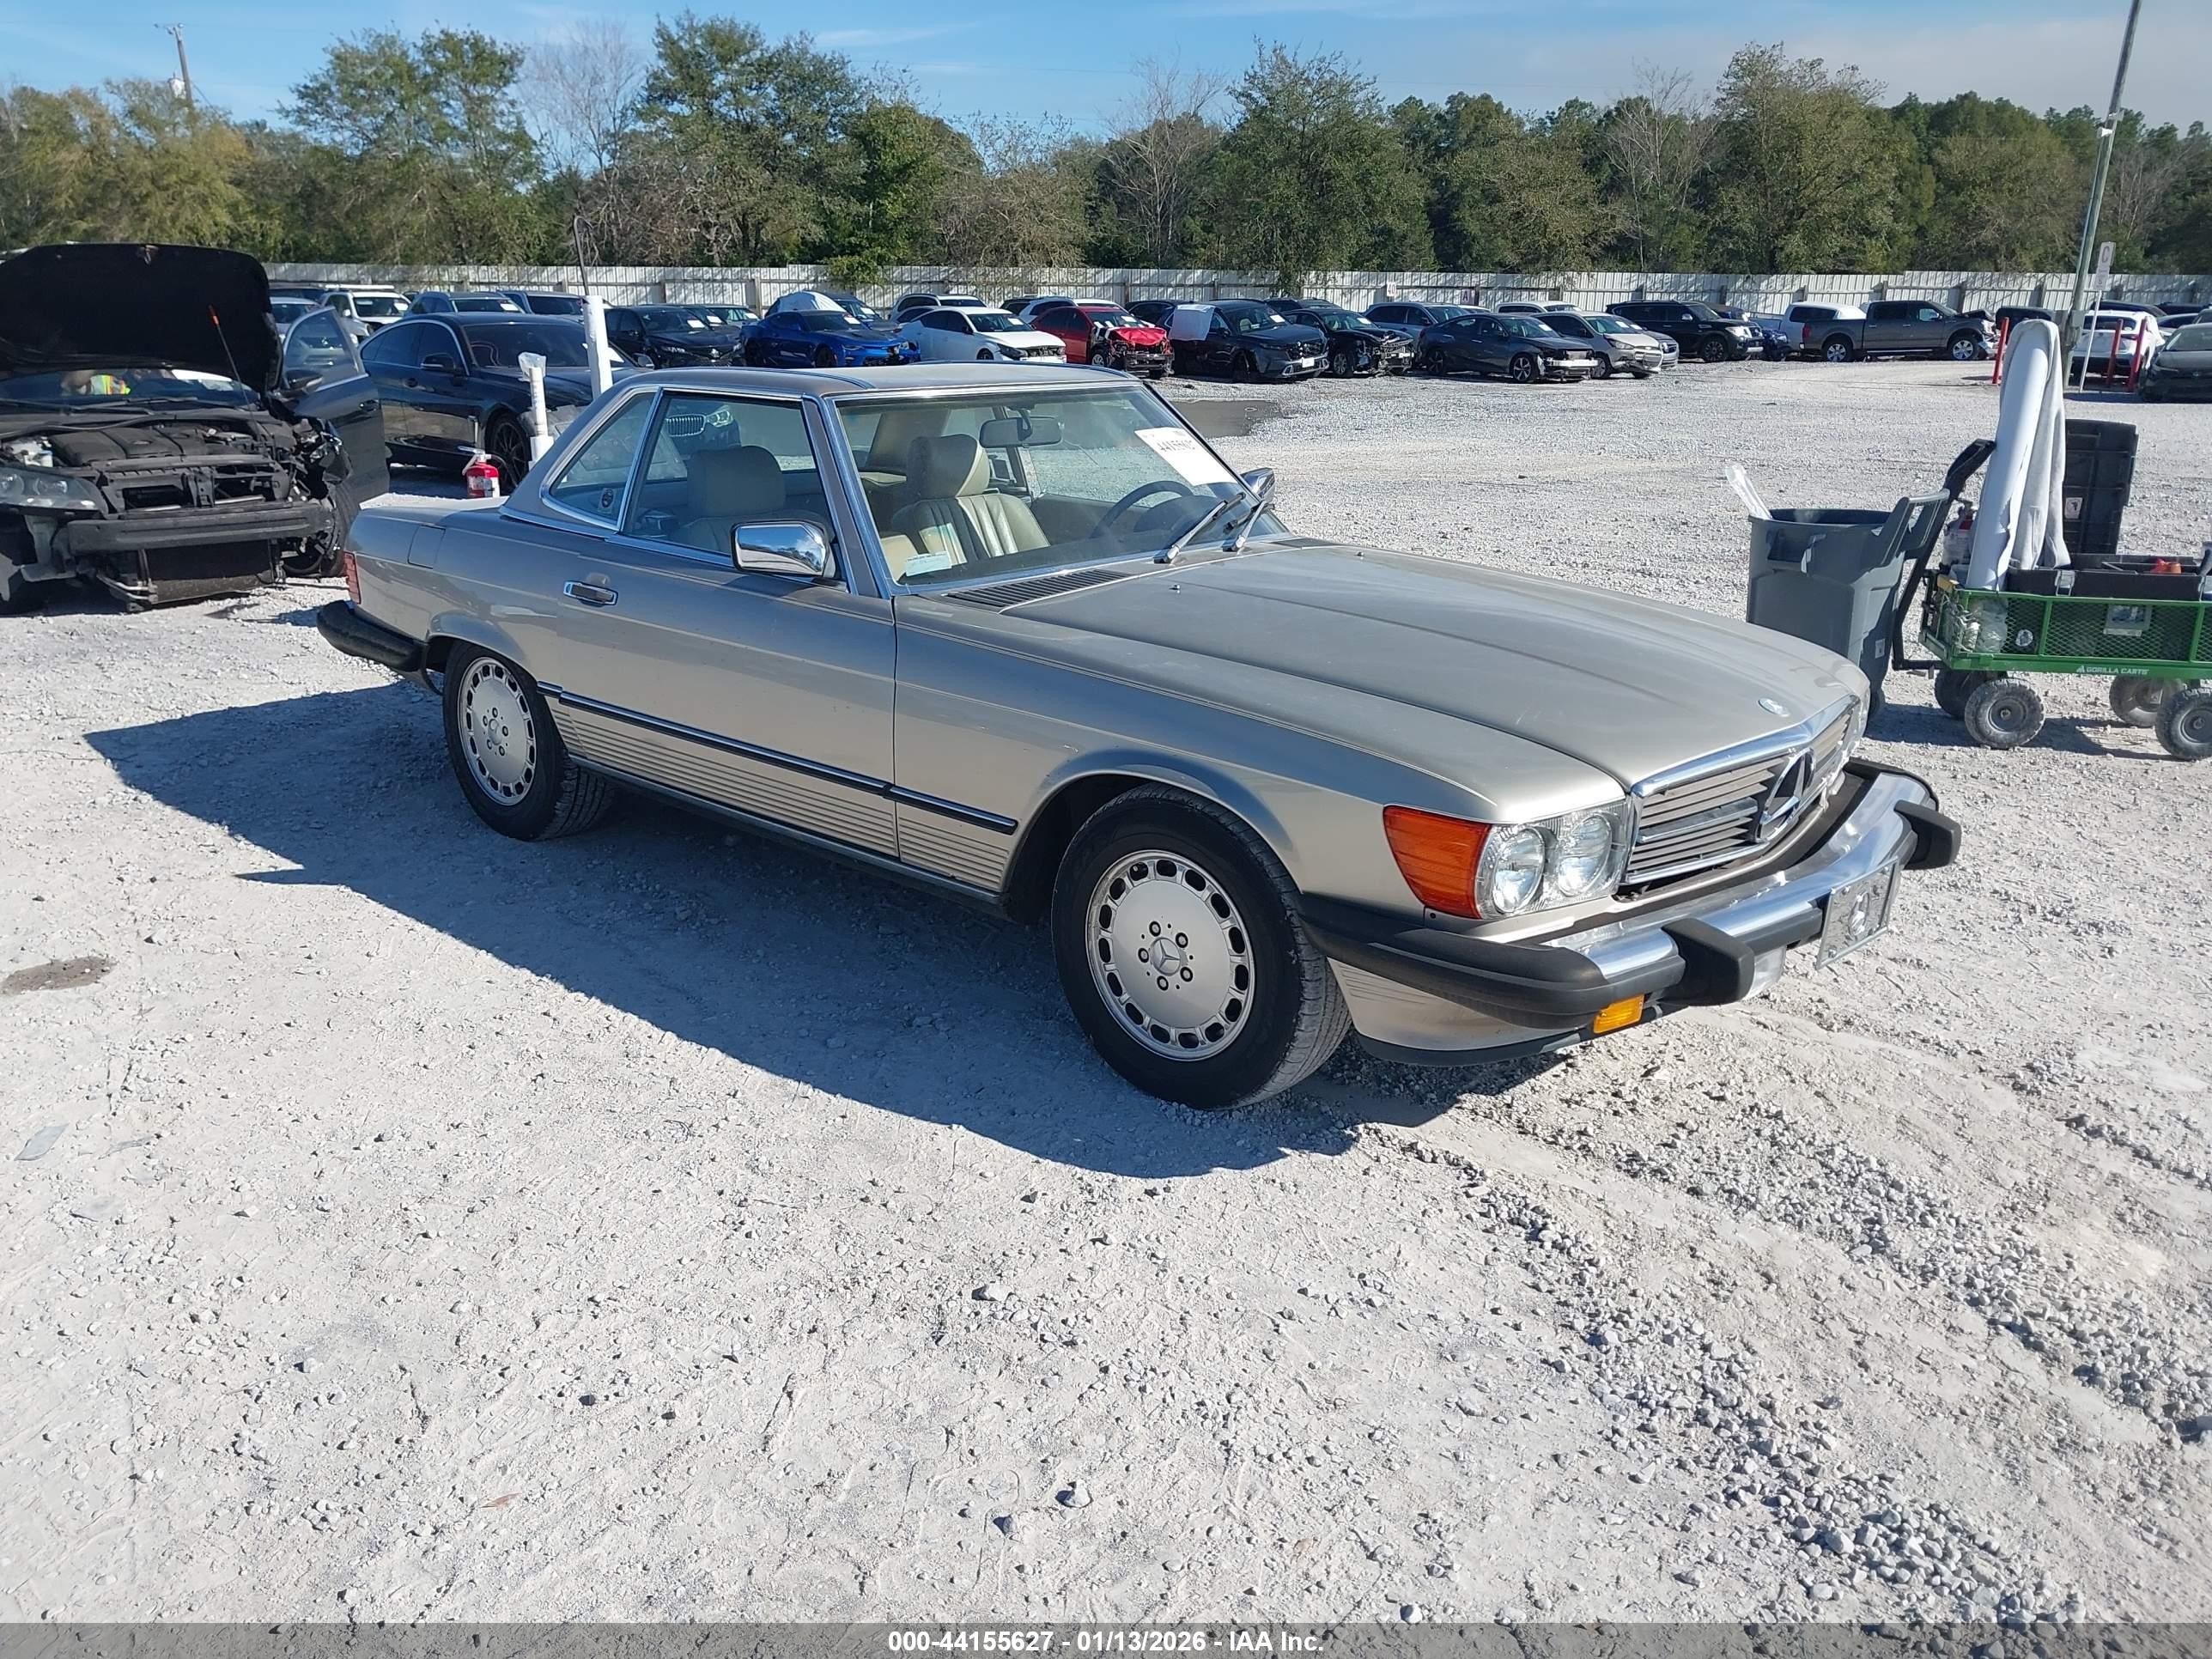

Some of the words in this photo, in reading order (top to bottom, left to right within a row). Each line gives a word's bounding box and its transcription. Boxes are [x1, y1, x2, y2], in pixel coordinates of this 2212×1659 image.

[2102, 246, 2110, 262] C
[1388, 283, 1395, 295] 40
[1462, 291, 1468, 301] A
